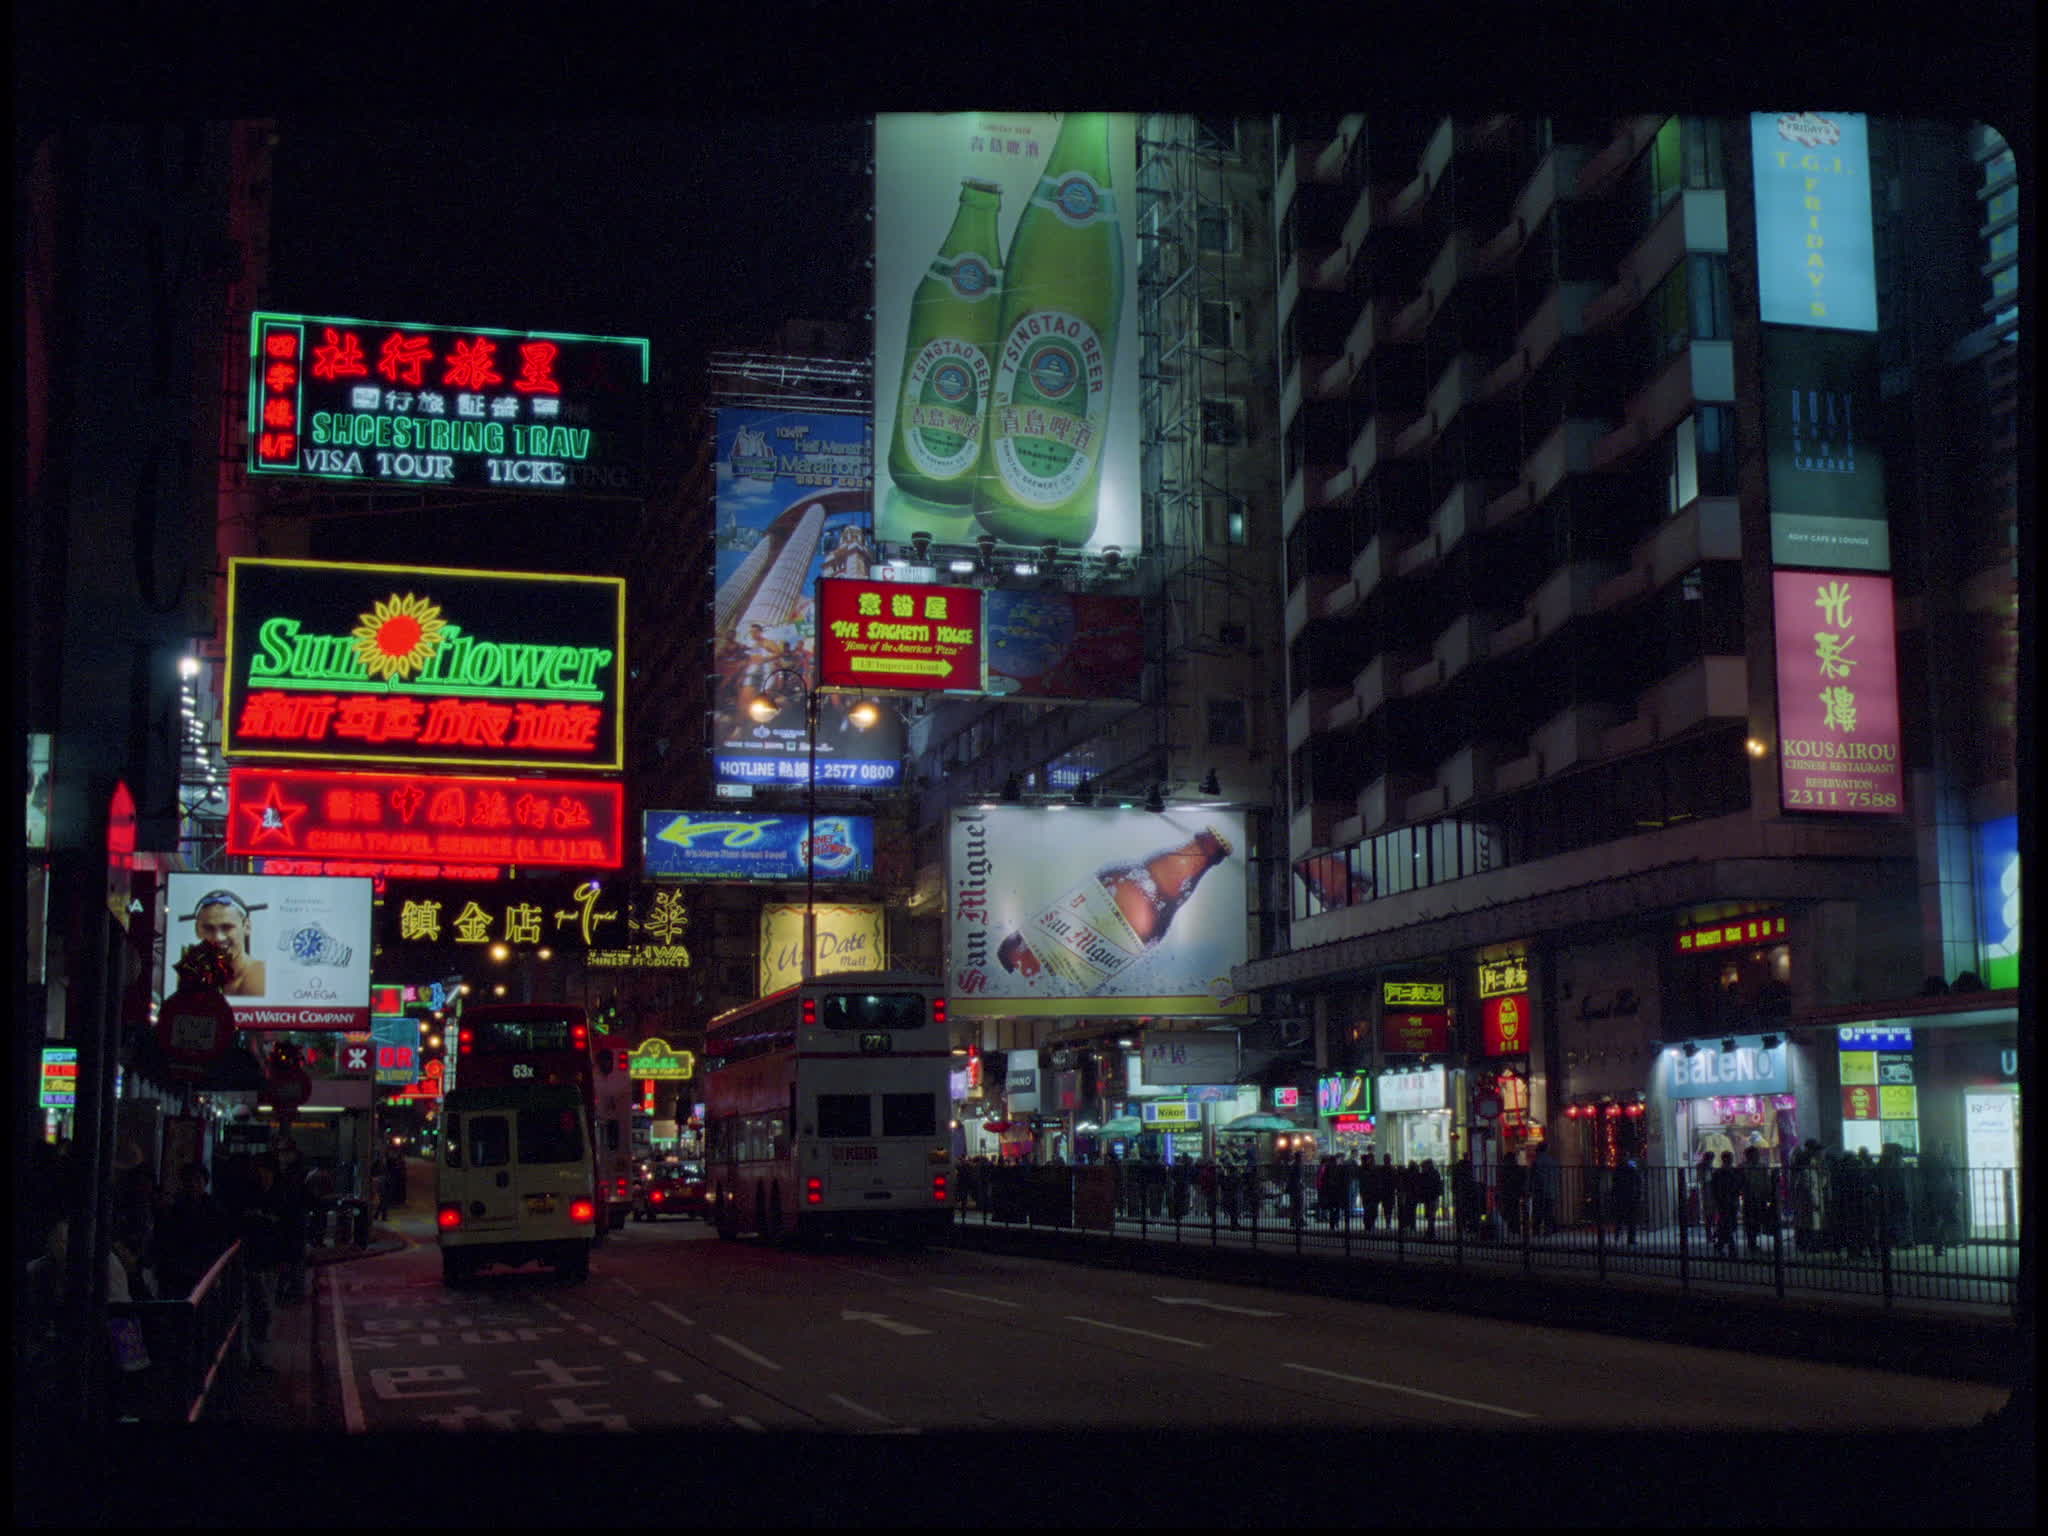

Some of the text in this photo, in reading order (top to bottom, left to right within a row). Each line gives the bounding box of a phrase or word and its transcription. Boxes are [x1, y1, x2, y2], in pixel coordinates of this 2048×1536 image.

[1002, 315, 1104, 394] TSINGTAO BEER
[911, 341, 990, 400] TSINGTAO BEER
[312, 411, 505, 454] SHOESTRING
[1002, 406, 1096, 450] 青島啤酒
[304, 448, 365, 475] VISA
[377, 452, 455, 480] TOUR
[867, 621, 930, 643] SPAGHETTI
[1783, 738, 1896, 761] KOUSAIROU
[720, 761, 775, 777] HOTLINE
[825, 763, 858, 779] 2577
[861, 764, 895, 780] 0800
[1788, 788, 1897, 808] 2311 7588
[365, 832, 433, 854] TRAVEL
[957, 814, 993, 994] San Miguel
[400, 899, 543, 944] 鎮金店
[816, 931, 866, 960] Date
[1040, 910, 1129, 970] San Miguel
[293, 990, 338, 1000] OMEGA
[233, 1010, 356, 1025] ON WATCH COMPANY
[1158, 1107, 1186, 1118] Nikon
